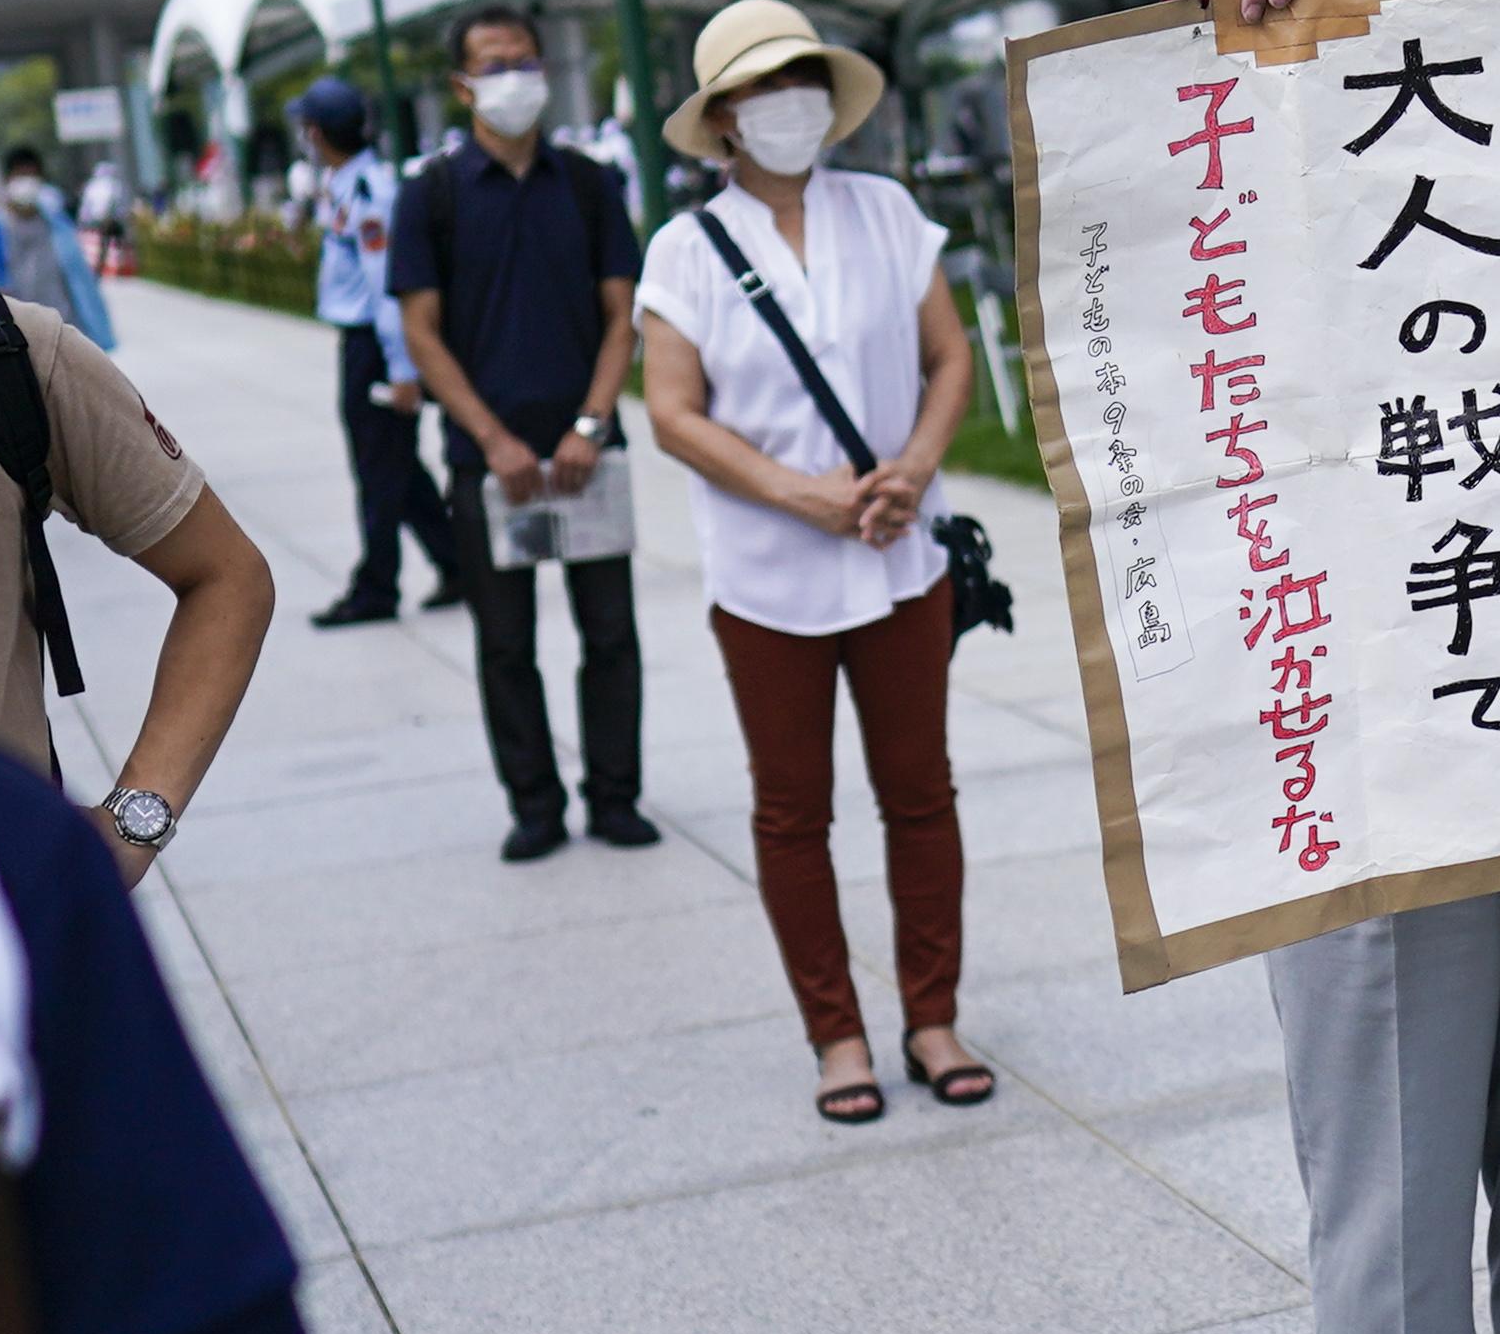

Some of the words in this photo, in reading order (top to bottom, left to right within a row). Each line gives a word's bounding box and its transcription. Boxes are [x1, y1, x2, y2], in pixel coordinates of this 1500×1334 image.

[1168, 76, 1341, 873] 子どもたちを泣かせるな
